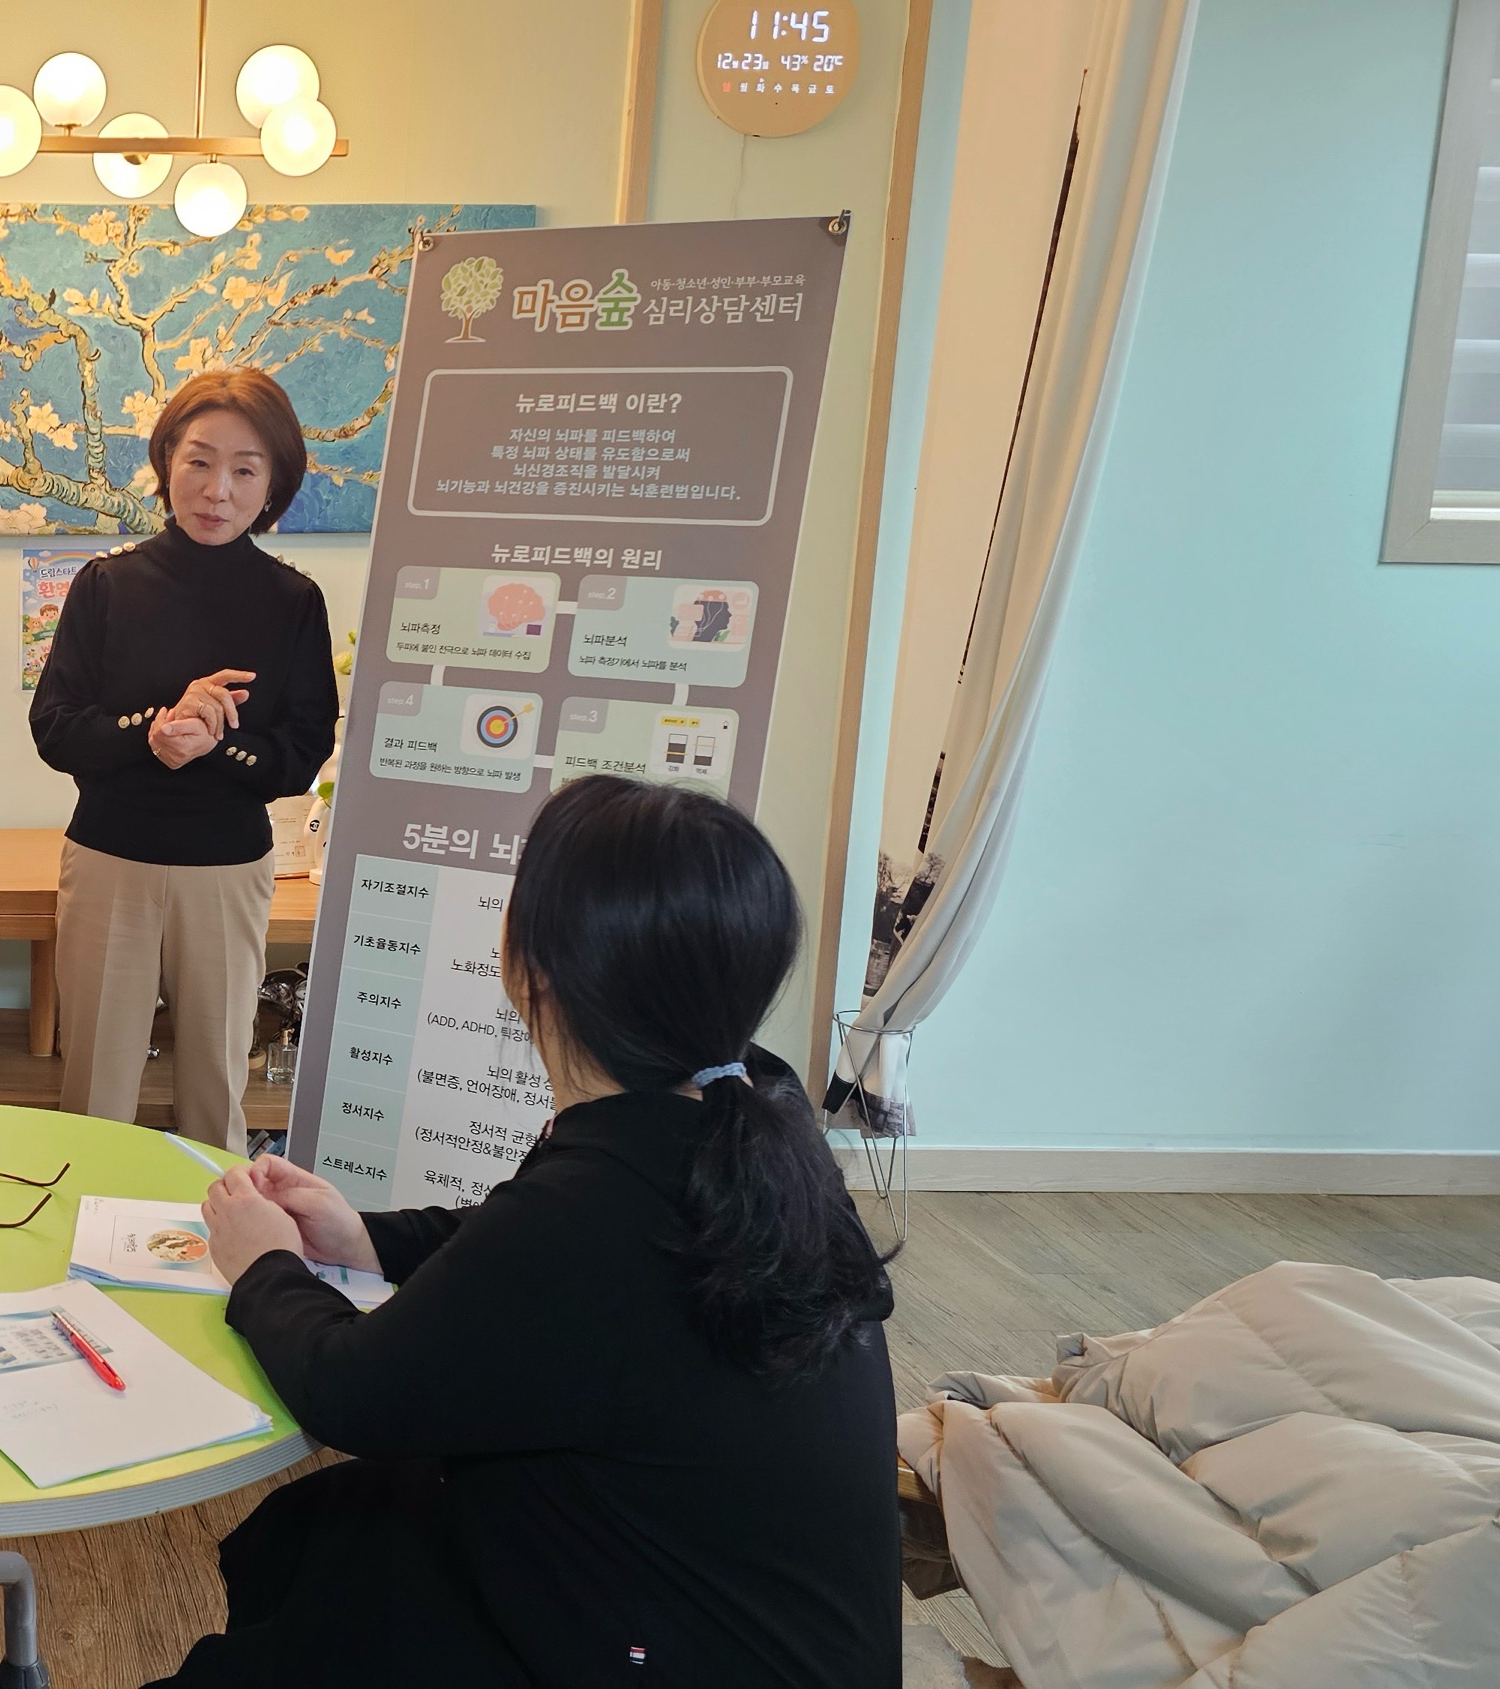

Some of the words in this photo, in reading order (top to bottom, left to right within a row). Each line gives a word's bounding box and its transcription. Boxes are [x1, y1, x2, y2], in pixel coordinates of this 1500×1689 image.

[749, 10, 830, 43] 11:45
[512, 268, 641, 333] 마음숲
[643, 292, 804, 326] 심리상담센터
[515, 393, 618, 414] 뉴로피드백
[625, 393, 683, 414] 이란?
[509, 428, 551, 443] 자신의
[555, 429, 598, 443] 뇌파를
[601, 429, 676, 444] 피드백하여
[491, 445, 518, 460] 특정
[522, 446, 550, 460] 뇌파
[554, 446, 597, 460] 상태를
[601, 447, 691, 462] 유도함으로써
[513, 463, 598, 479] 뇌신경조직을
[602, 464, 661, 480] 발달시켜
[436, 479, 491, 494] 뇌기능과
[494, 480, 550, 495] 뇌건강을
[553, 481, 625, 497] 증진시키는
[629, 484, 741, 500] 뇌훈련법입니다.
[491, 544, 613, 568] 뉴로피드백의
[621, 548, 662, 570] 원리
[400, 621, 441, 635] 뇌파측정
[583, 633, 628, 648] 뇌파분석
[471, 647, 488, 657] 뇌파
[489, 648, 513, 658] 데이터
[515, 651, 531, 661] 수집
[579, 655, 596, 665] 뇌파
[641, 660, 667, 670] 뇌파를
[668, 661, 687, 671] 분석
[384, 737, 404, 749] 결과
[407, 740, 438, 753] 피드백
[565, 756, 598, 769] 피드백
[601, 760, 646, 774] 조건분석
[402, 822, 480, 860] 5분의
[489, 834, 527, 866] 뇌
[360, 878, 430, 899] 자기조절지수
[478, 896, 504, 912] 뇌의
[353, 934, 422, 956] 기초율동지수
[451, 958, 501, 978] 노화정도
[357, 991, 402, 1009] 주의지수
[494, 1008, 520, 1024] 뇌의
[349, 1046, 394, 1066] 활성지수
[486, 1065, 513, 1082] 뇌의
[515, 1070, 541, 1089] 활성
[341, 1100, 385, 1122] 정서지수
[469, 1120, 508, 1141] 정서적
[511, 1130, 538, 1148] 균형
[322, 1155, 388, 1181] 스트레스지수
